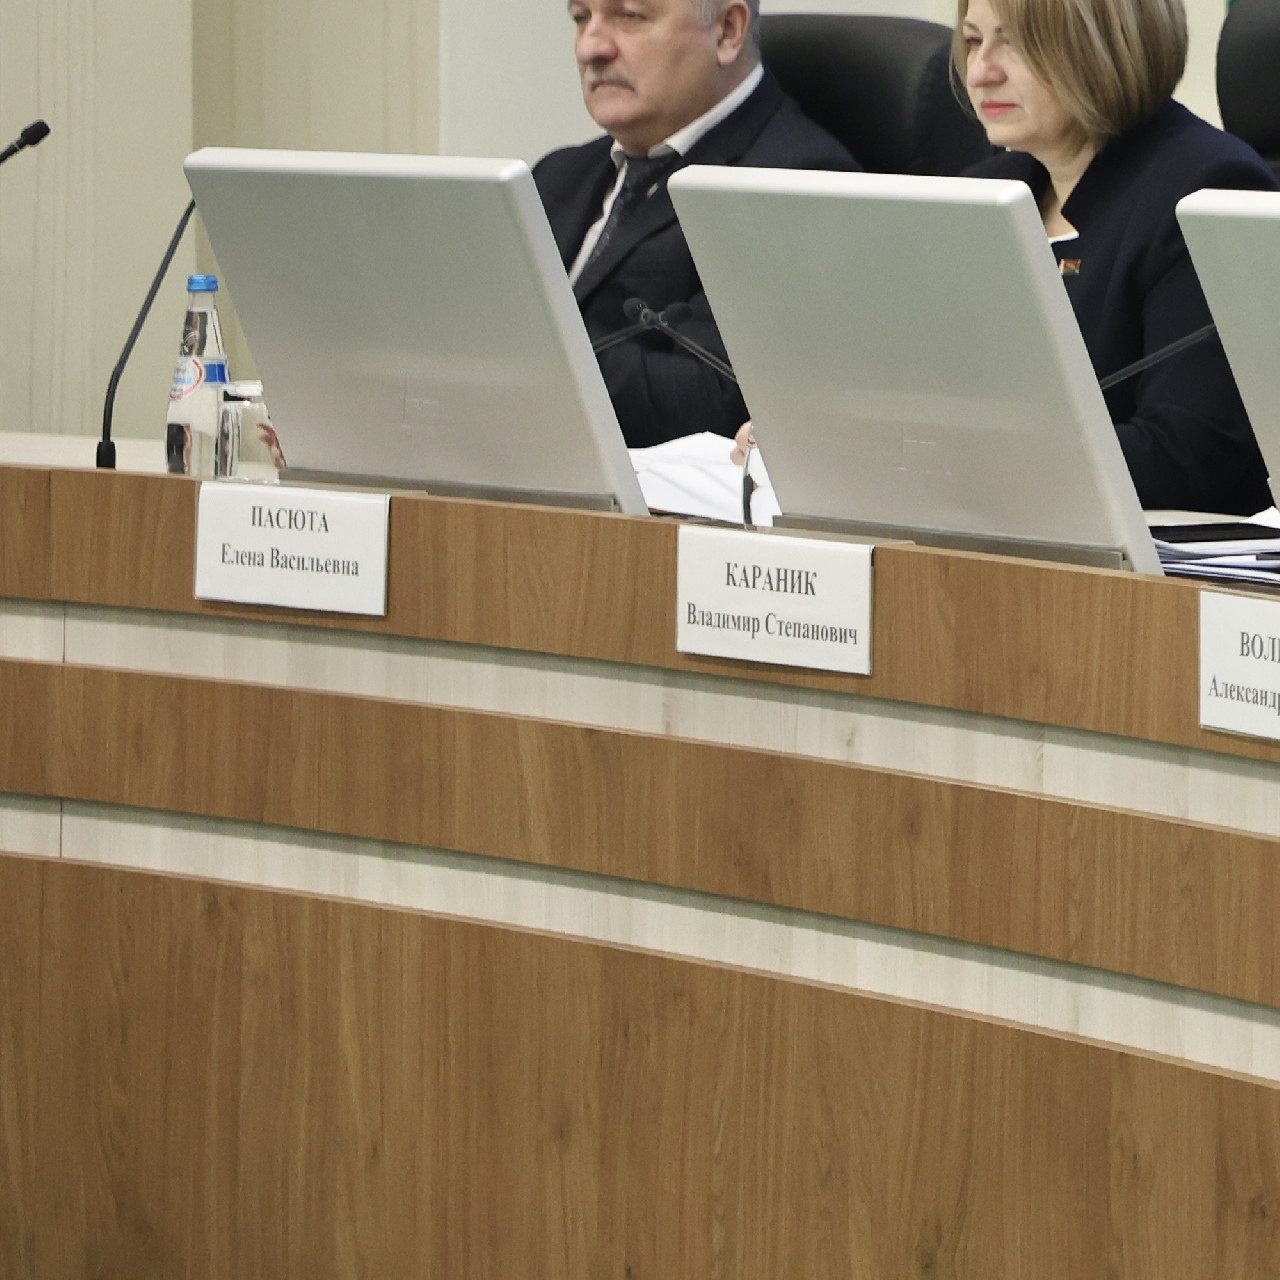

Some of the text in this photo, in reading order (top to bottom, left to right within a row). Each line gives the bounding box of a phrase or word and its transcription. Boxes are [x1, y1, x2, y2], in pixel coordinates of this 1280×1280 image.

[251, 505, 329, 533] ПАСЮТА
[221, 543, 360, 577] Елена Васильевна
[725, 562, 818, 596] КАРАНИК
[686, 602, 858, 646] Владимир Степанович
